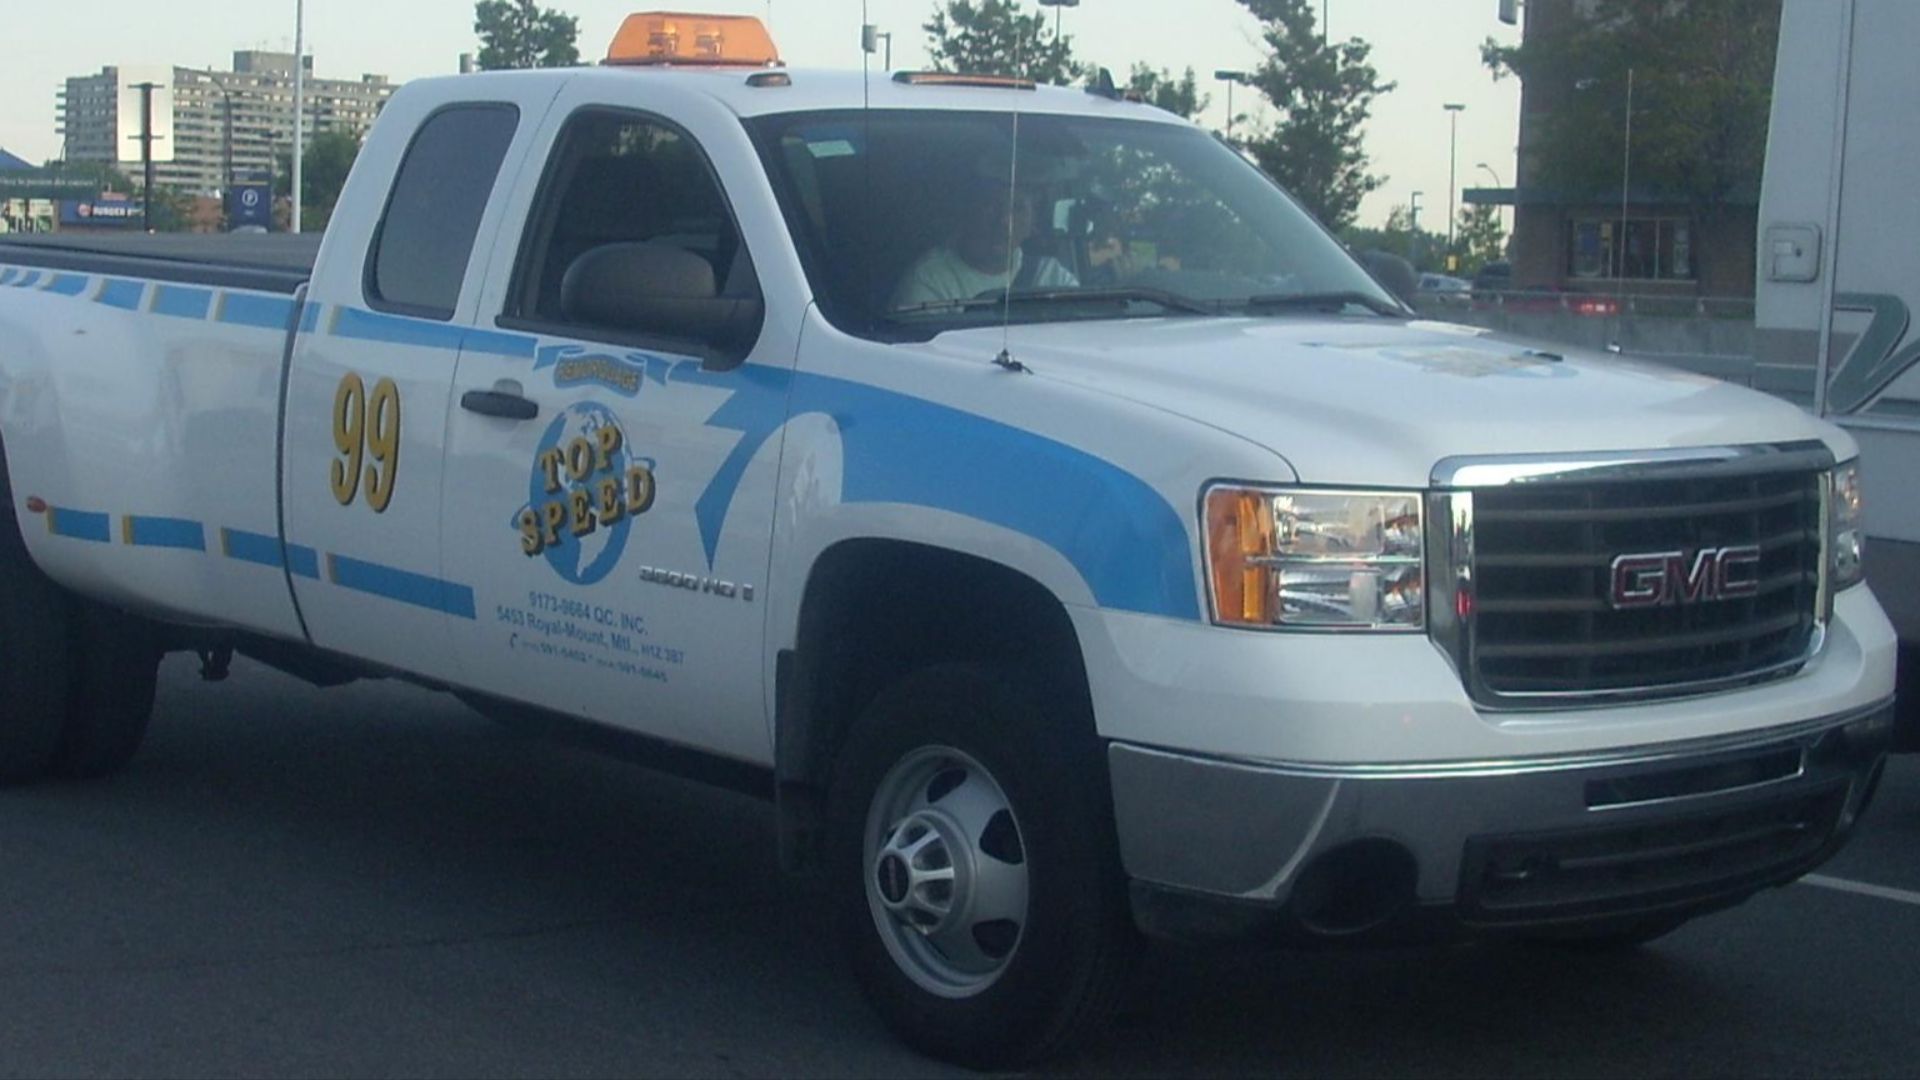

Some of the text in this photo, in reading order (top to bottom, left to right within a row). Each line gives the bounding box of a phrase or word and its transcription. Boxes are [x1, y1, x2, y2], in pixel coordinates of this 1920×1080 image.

[331, 371, 400, 513] 99
[540, 425, 622, 493] TOP
[519, 466, 656, 557] SPEED
[1611, 545, 1760, 609] GMC
